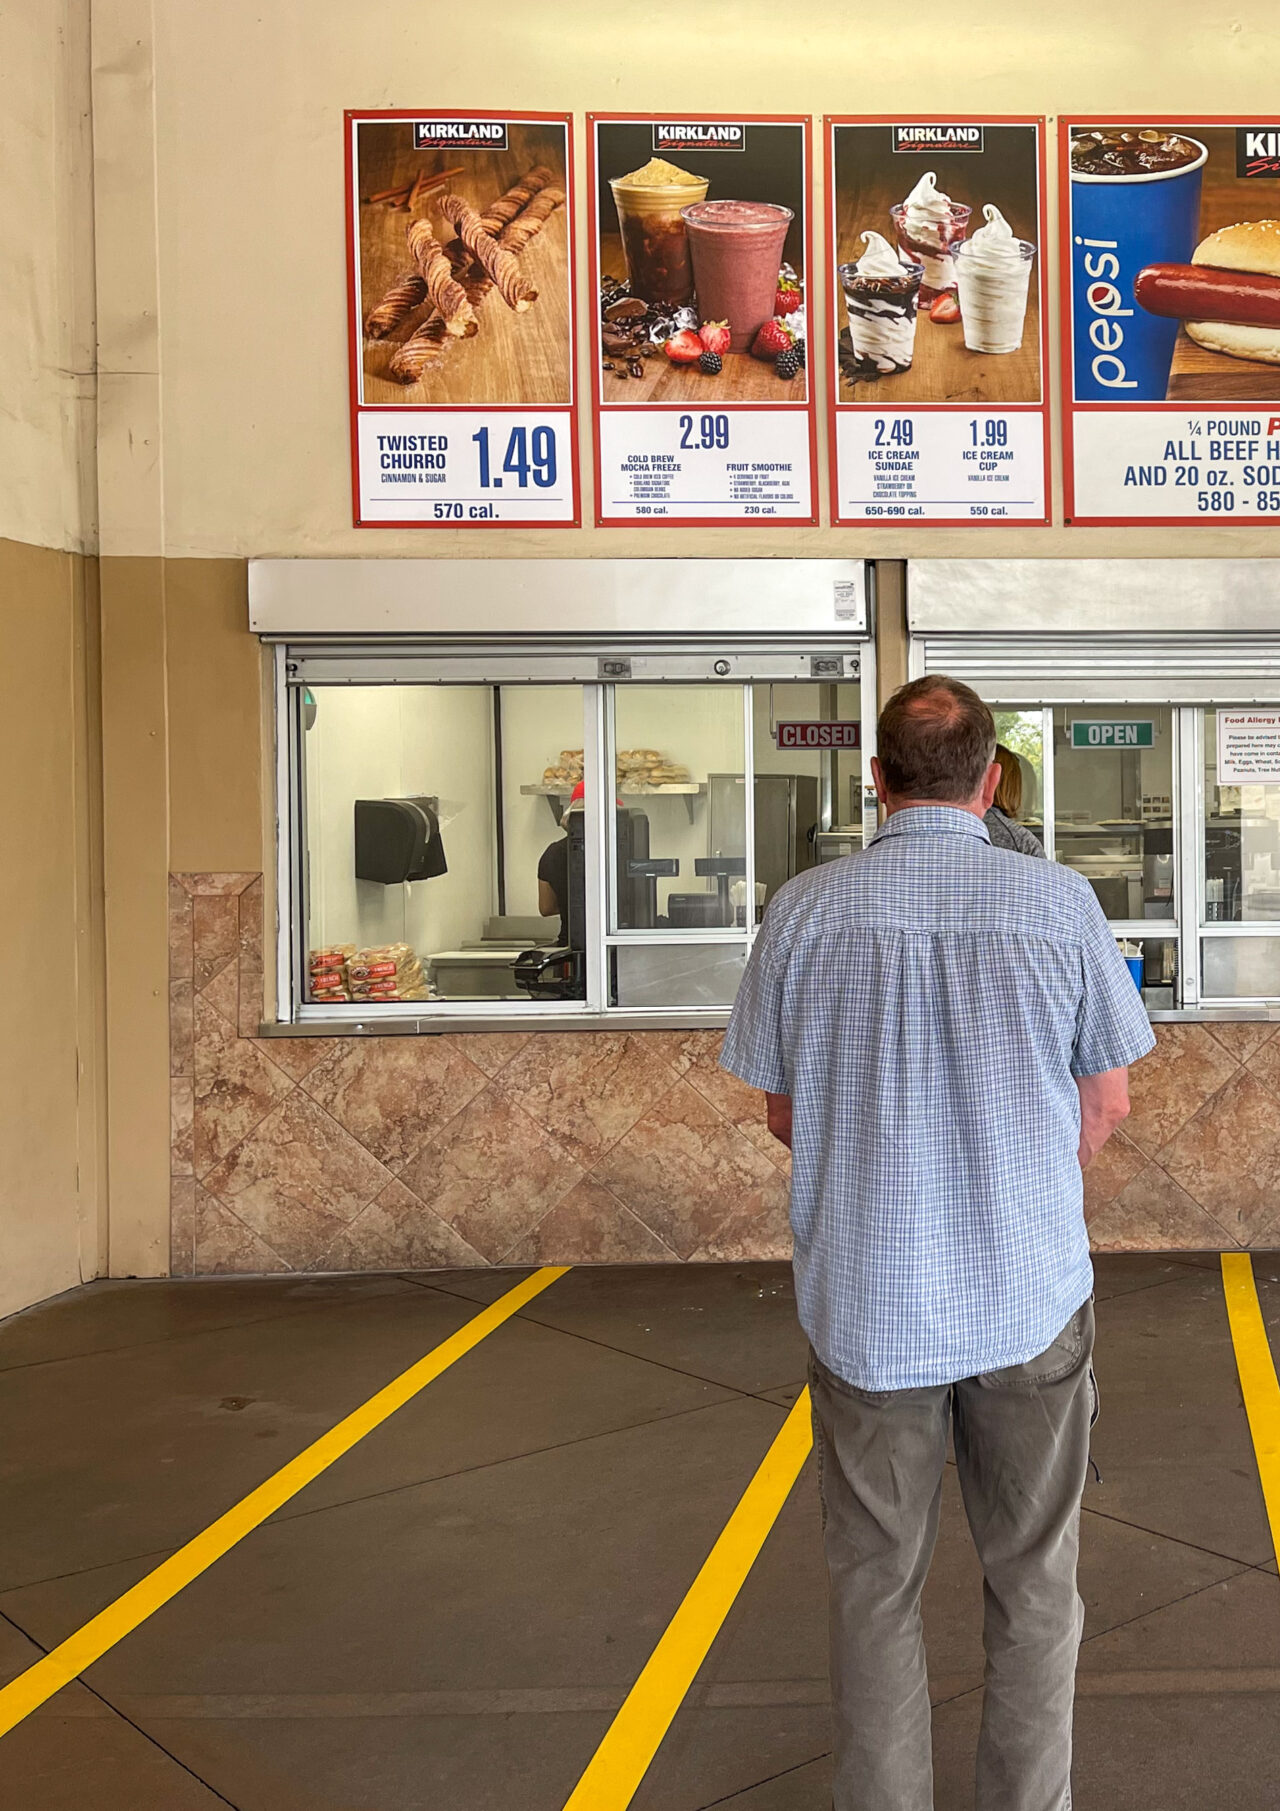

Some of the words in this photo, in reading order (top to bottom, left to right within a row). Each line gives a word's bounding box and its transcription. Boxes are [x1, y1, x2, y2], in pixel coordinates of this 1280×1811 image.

[419, 124, 504, 138] KIRKLAND
[658, 126, 741, 140] KIRKLAND
[898, 128, 979, 141] KIRKLAND
[419, 136, 503, 149] Signature
[659, 139, 741, 151] Signature
[898, 141, 979, 152] Signature
[1074, 235, 1138, 388] pepsi
[679, 414, 729, 449] 2.99
[874, 419, 913, 446] 2.49
[969, 419, 1007, 446] 1.99
[1207, 420, 1261, 436] POUND
[377, 436, 448, 451] TWISTED
[472, 425, 557, 488] 1.49
[868, 451, 884, 460] ICE
[886, 451, 920, 460] CREAM
[963, 451, 977, 460] ICE
[980, 451, 1013, 460] CREAM
[1163, 440, 1202, 461] ALL
[1210, 440, 1259, 461] BEEF
[380, 453, 446, 469] CHURRO
[627, 455, 648, 463] COLD
[651, 455, 675, 463] BREW
[621, 463, 650, 471] MOCHA
[652, 463, 682, 471] FREEZE
[726, 463, 749, 471] FRUIT
[751, 463, 792, 471] SMOOTHIE
[875, 462, 913, 471] SUNDAE
[979, 462, 998, 471] CUP
[381, 473, 417, 483] CINNAMON
[418, 473, 424, 483] &
[425, 473, 446, 483] SUGAR
[1124, 466, 1167, 486] AND
[1174, 466, 1199, 486] 20
[1207, 471, 1235, 486] oz.
[1197, 492, 1236, 512] 580
[434, 503, 463, 518] 570
[469, 503, 499, 518] cal.
[635, 506, 652, 514] 580
[653, 506, 669, 514] cal.
[744, 506, 760, 514] 230
[762, 506, 777, 514] cal.
[865, 506, 905, 515] 650-690
[908, 506, 925, 515] cal.
[970, 506, 988, 515] 550
[991, 506, 1008, 515] cal.
[782, 726, 856, 745] CLOSED
[1088, 725, 1138, 744] OPEN
